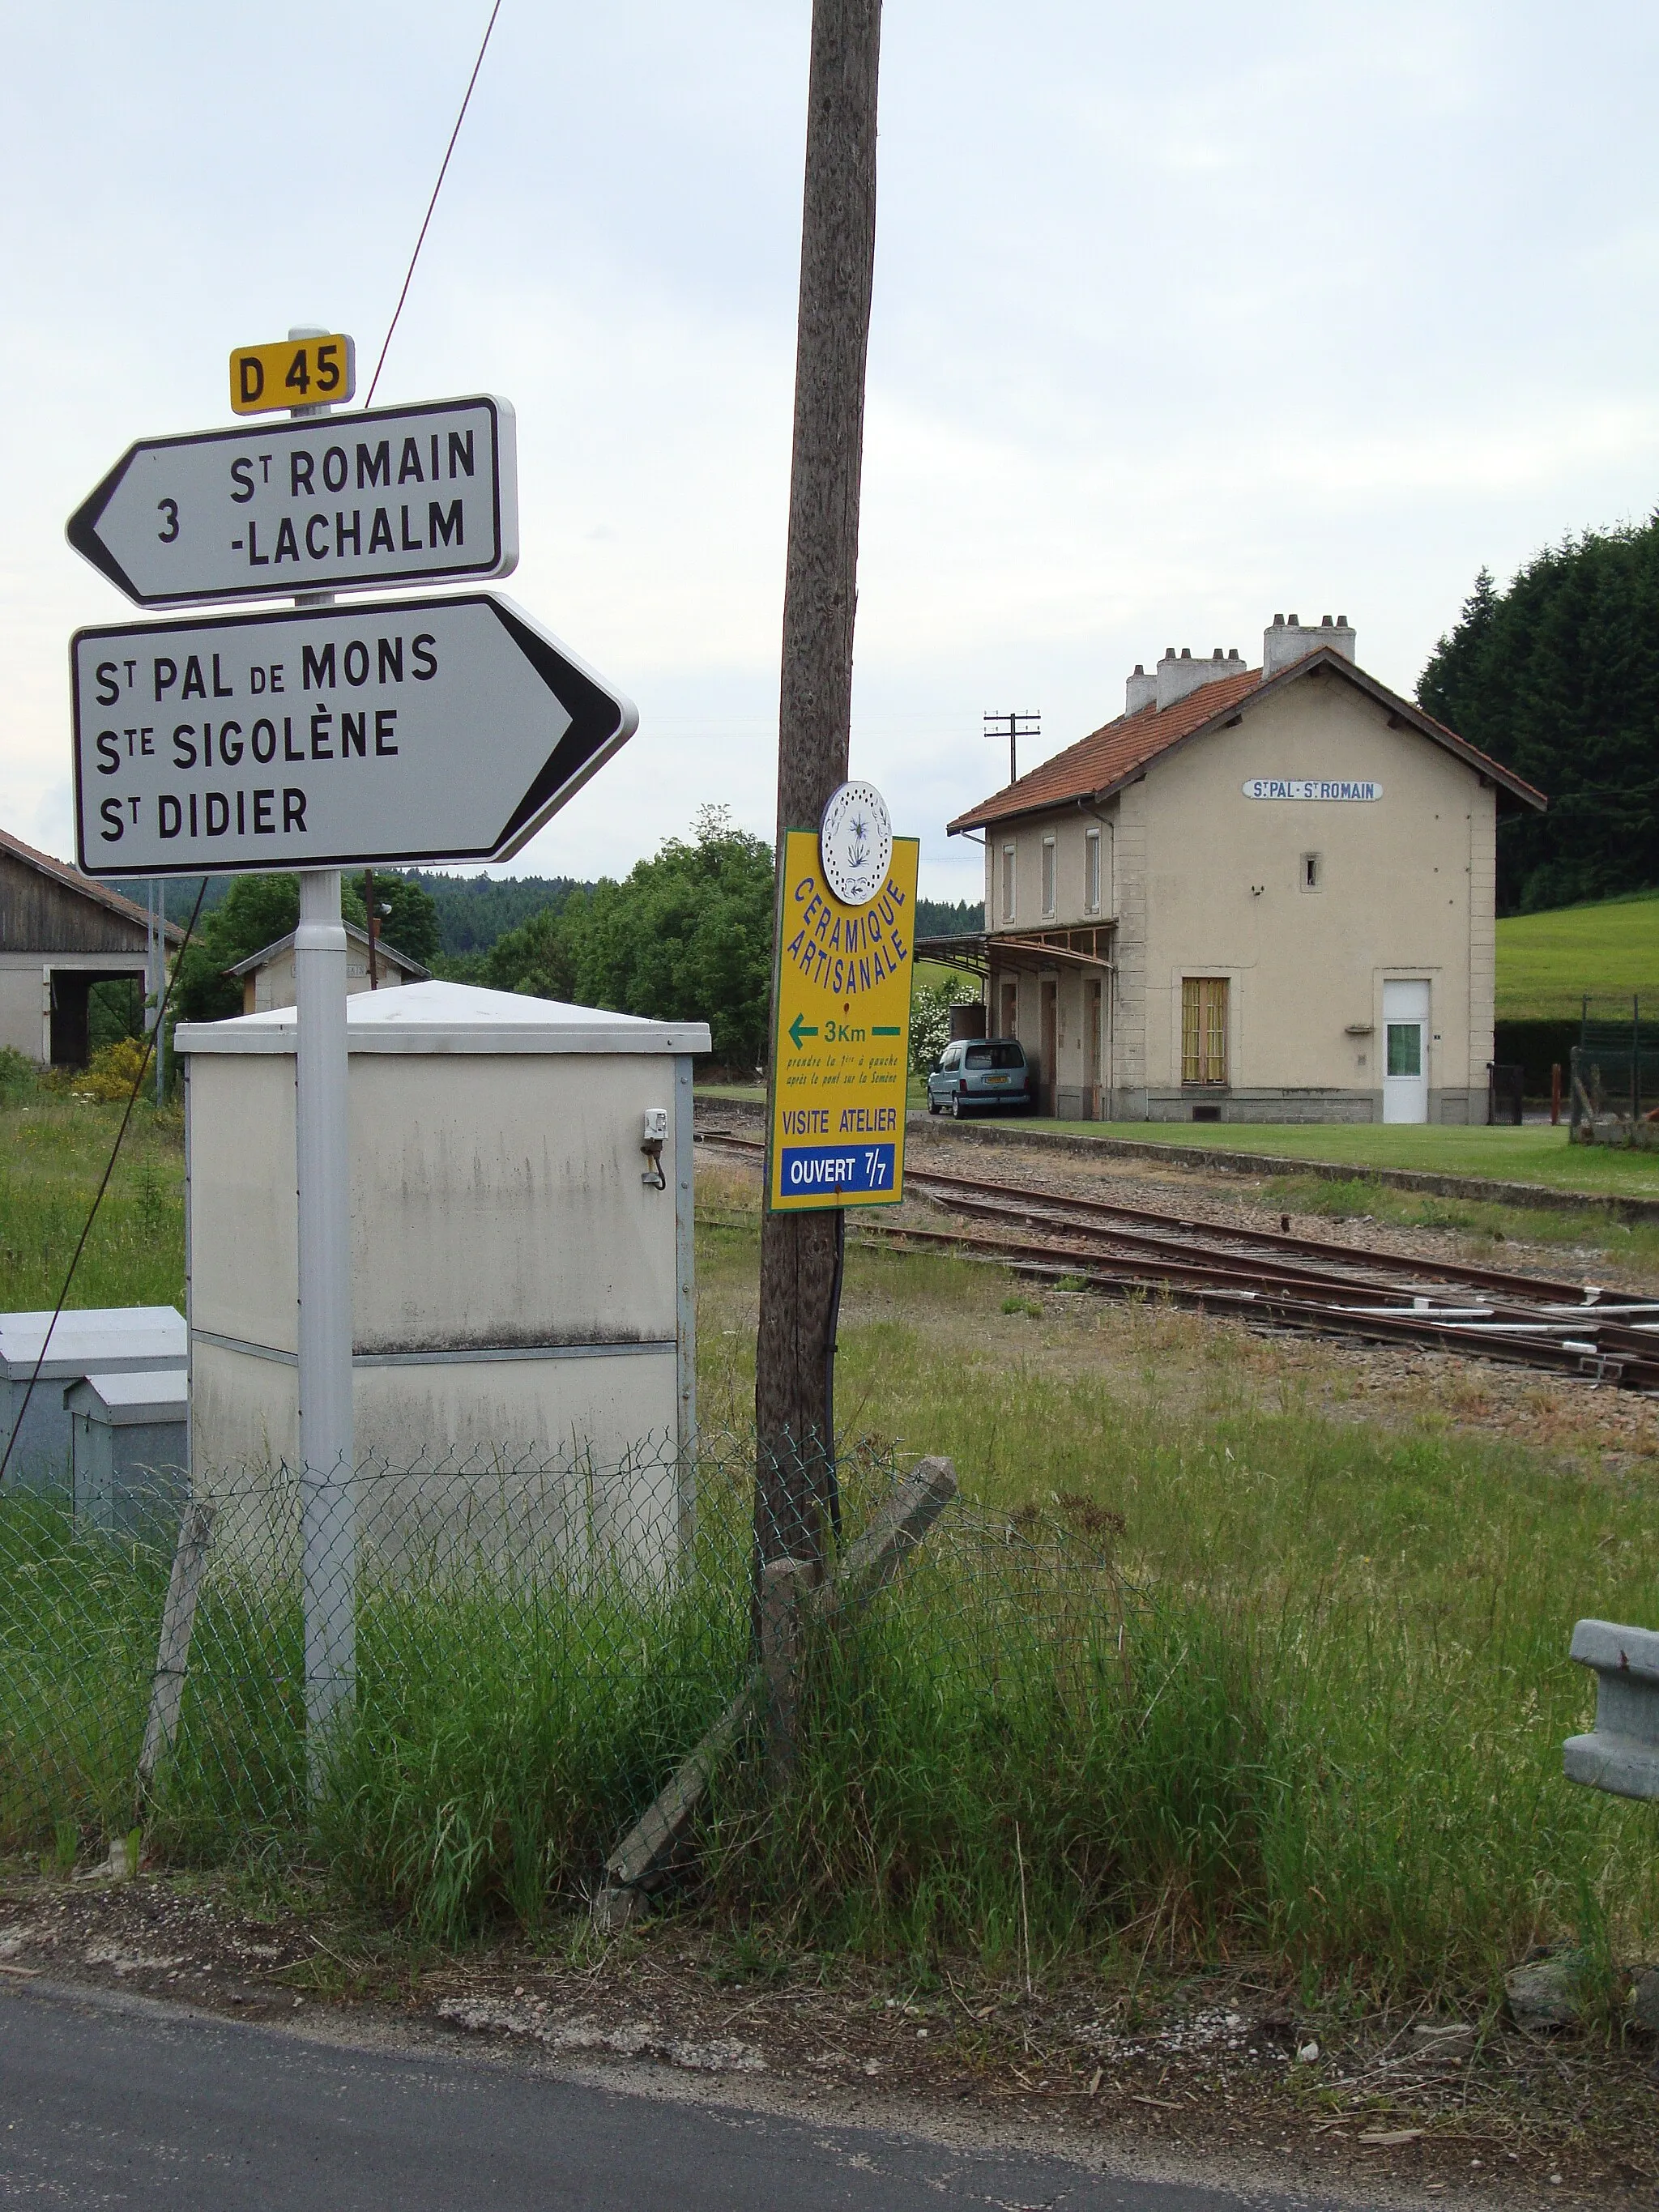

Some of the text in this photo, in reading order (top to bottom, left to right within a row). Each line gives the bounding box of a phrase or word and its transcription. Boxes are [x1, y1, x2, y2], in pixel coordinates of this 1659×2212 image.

[240, 344, 340, 403] D 45
[230, 428, 476, 504] ST ROMAIN
[157, 497, 180, 543] 3
[231, 498, 465, 567] -LACHALM
[95, 633, 438, 706] ST PAL DE MONS
[96, 703, 399, 775] STE SIGOLÈNE
[100, 787, 308, 842] ST DIDIER
[1320, 782, 1374, 799] ROMAIN
[795, 877, 906, 954] CERAMIQUE
[787, 928, 908, 995] ARTISANALE
[786, 1055, 823, 1071] prendre
[826, 1054, 836, 1067] la
[858, 1055, 864, 1066] à
[868, 1053, 898, 1069] gauche
[786, 1073, 808, 1087] après
[810, 1072, 819, 1085] le
[821, 1071, 842, 1087] pont
[843, 1074, 855, 1084] sur
[859, 1072, 868, 1084] la
[782, 1107, 897, 1135] VISITE ATELIER
[790, 1148, 887, 1187] OUVERT 7/7
